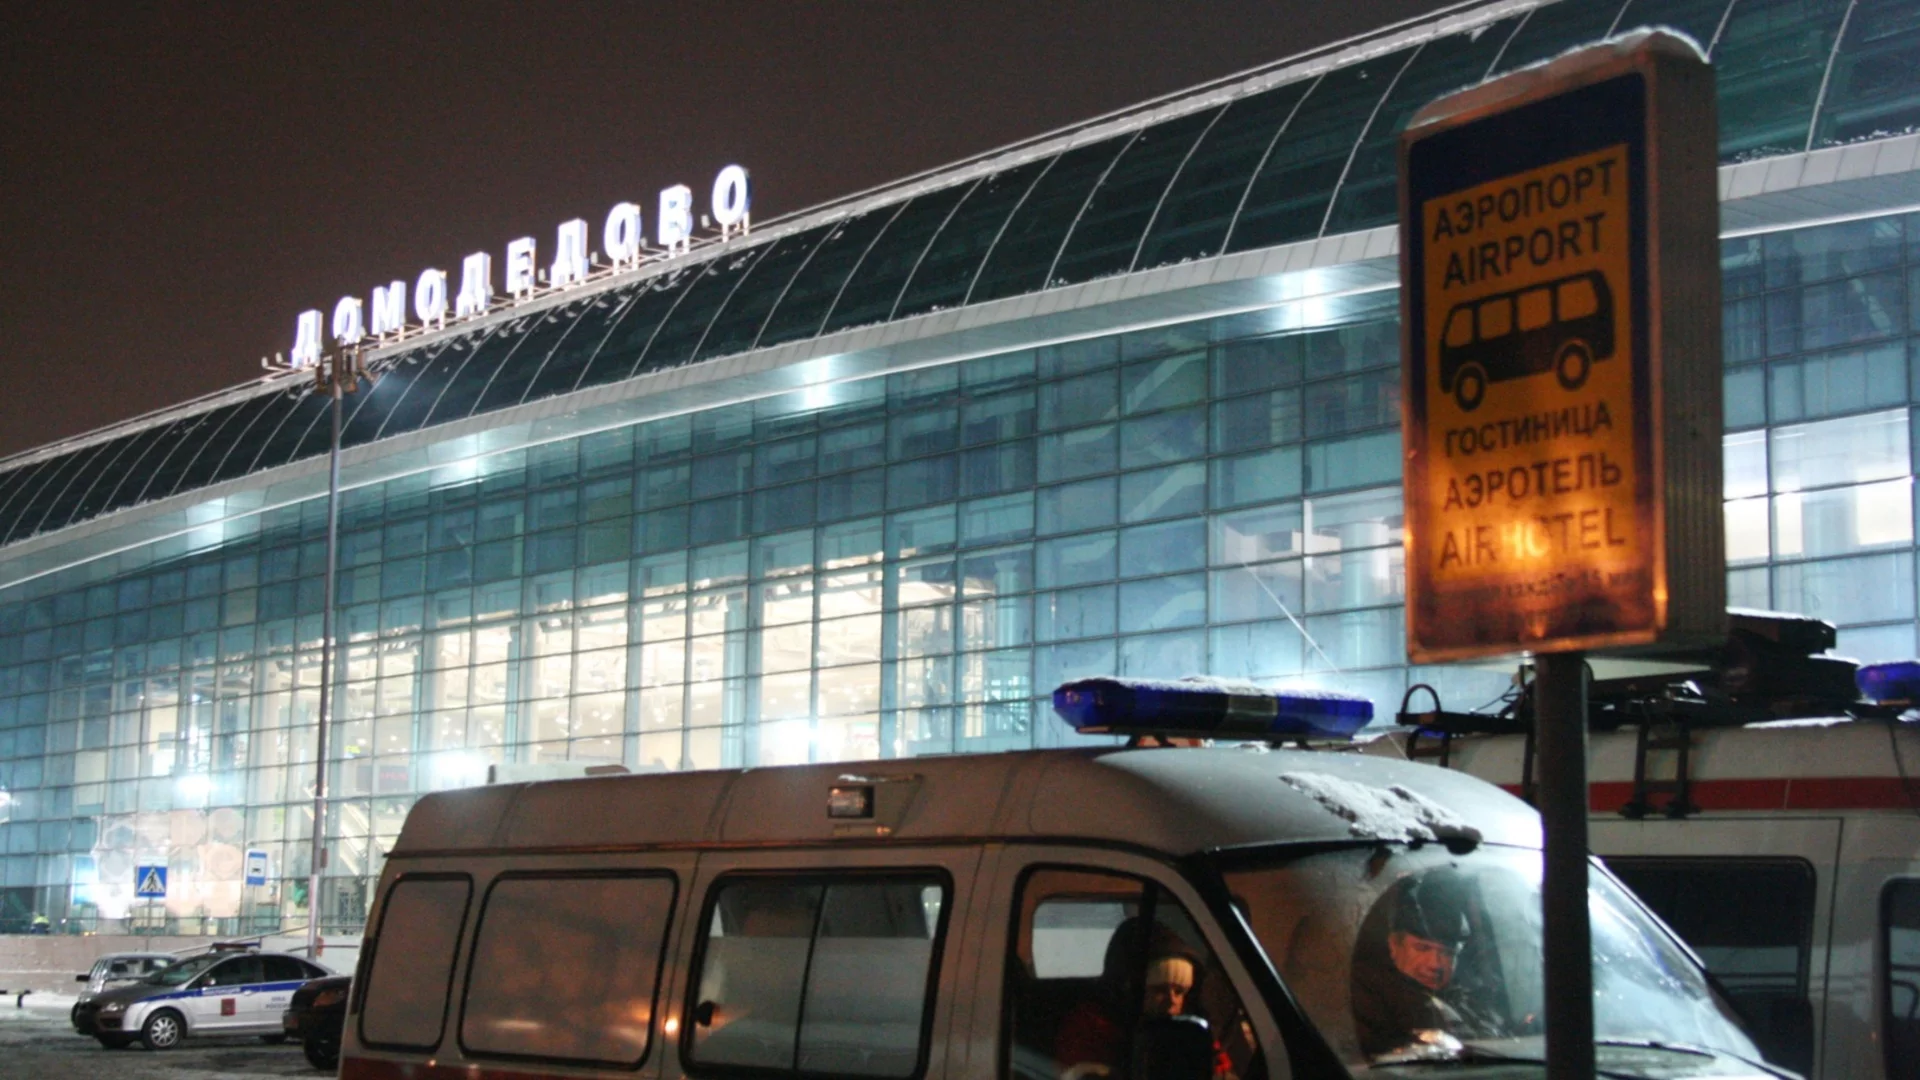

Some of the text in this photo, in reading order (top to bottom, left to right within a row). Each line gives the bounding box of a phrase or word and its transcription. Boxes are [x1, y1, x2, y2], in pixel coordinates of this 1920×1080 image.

[1433, 158, 1617, 243] АЭРОПОРТ
[290, 163, 752, 369] ДОМОДЕДОВО
[1443, 211, 1606, 290] AIRPORT
[1445, 400, 1613, 458] ГОСТИНИЦА
[1443, 452, 1622, 512] АЭРОТЕЛЬ
